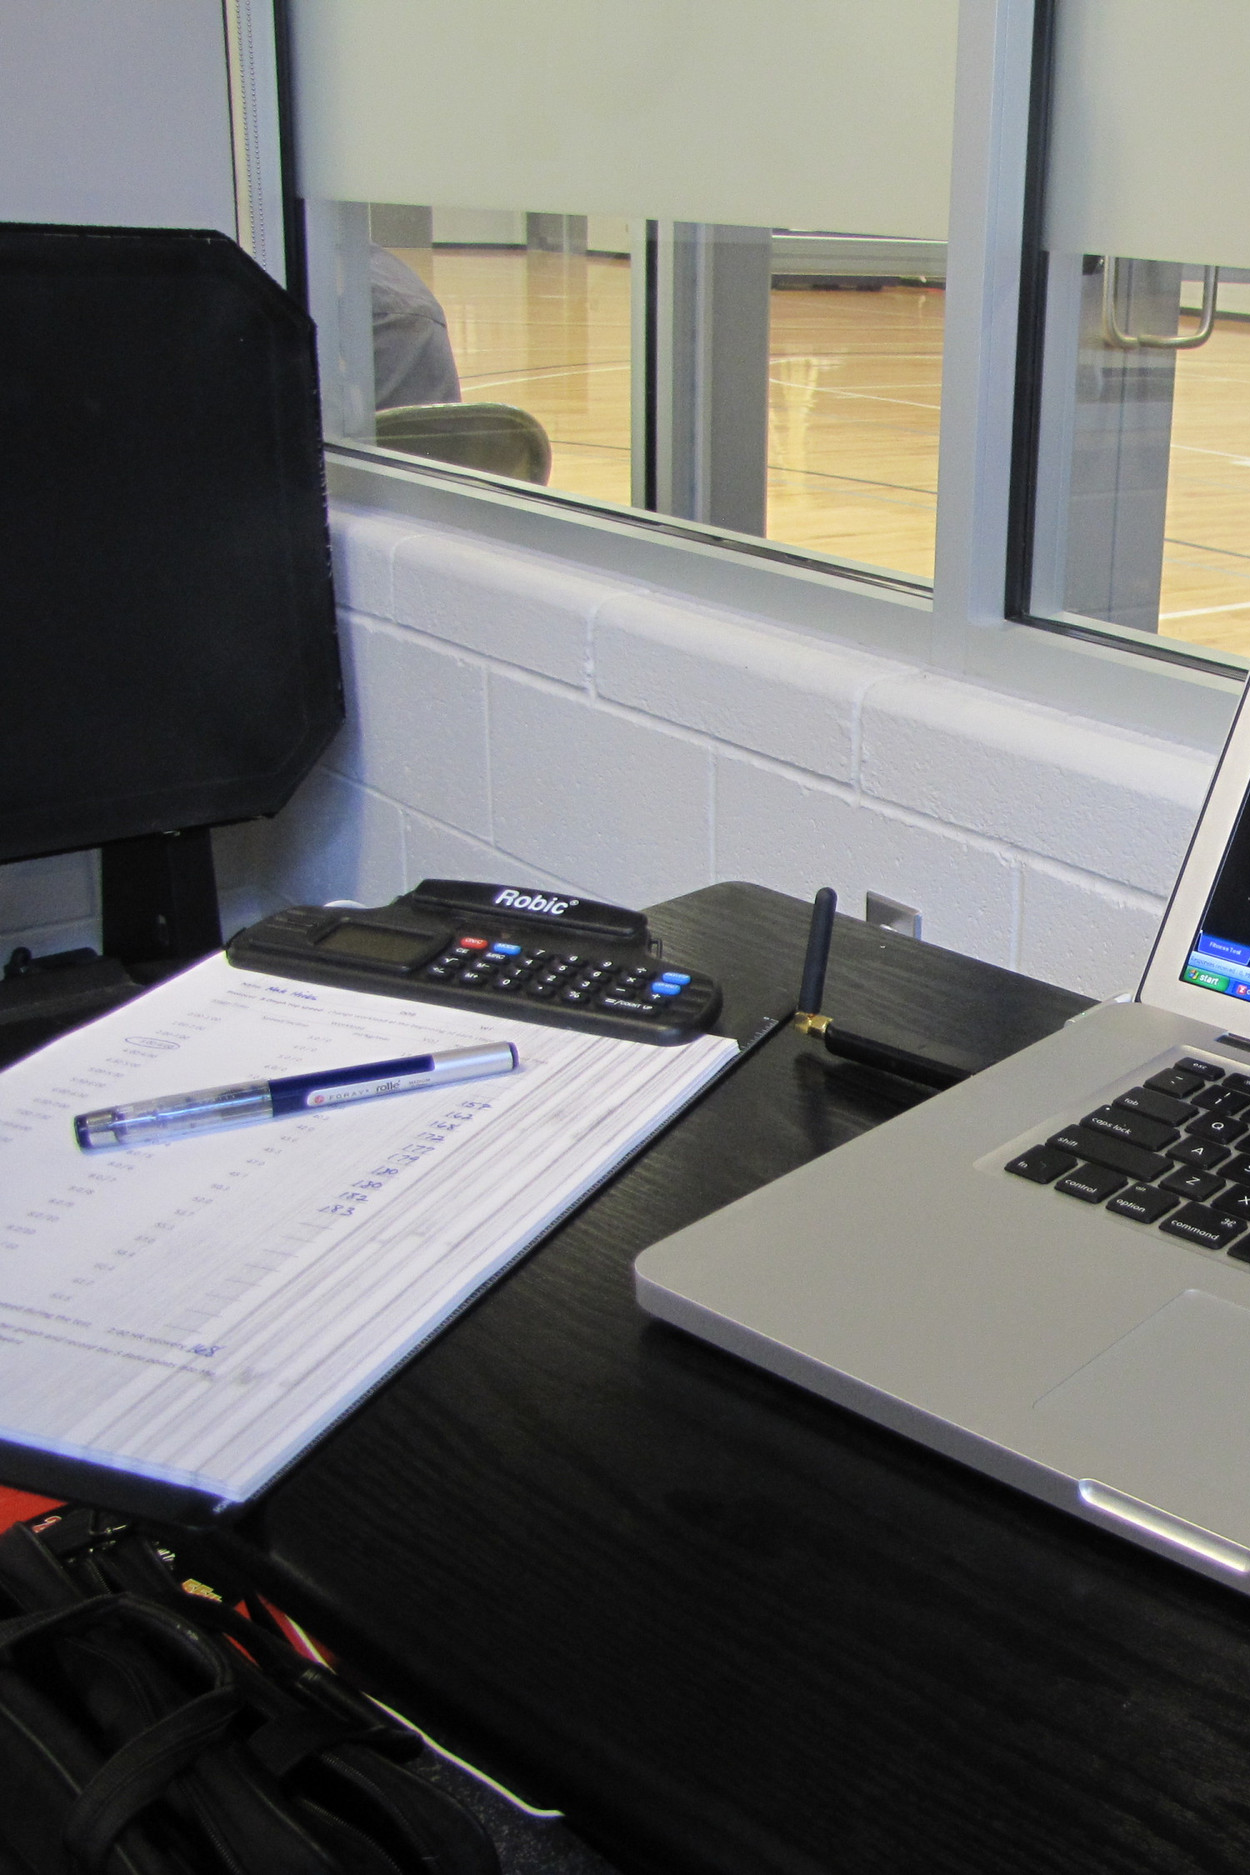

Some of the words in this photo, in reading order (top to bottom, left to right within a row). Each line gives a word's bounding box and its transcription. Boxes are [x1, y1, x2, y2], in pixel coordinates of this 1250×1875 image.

[1199, 973, 1220, 986] start
[1211, 1121, 1225, 1131] Q
[1191, 1146, 1205, 1156] A
[1065, 1177, 1098, 1194] control
[1185, 1176, 1200, 1186] Z
[1116, 1197, 1146, 1213] option
[1170, 1218, 1220, 1241] command
